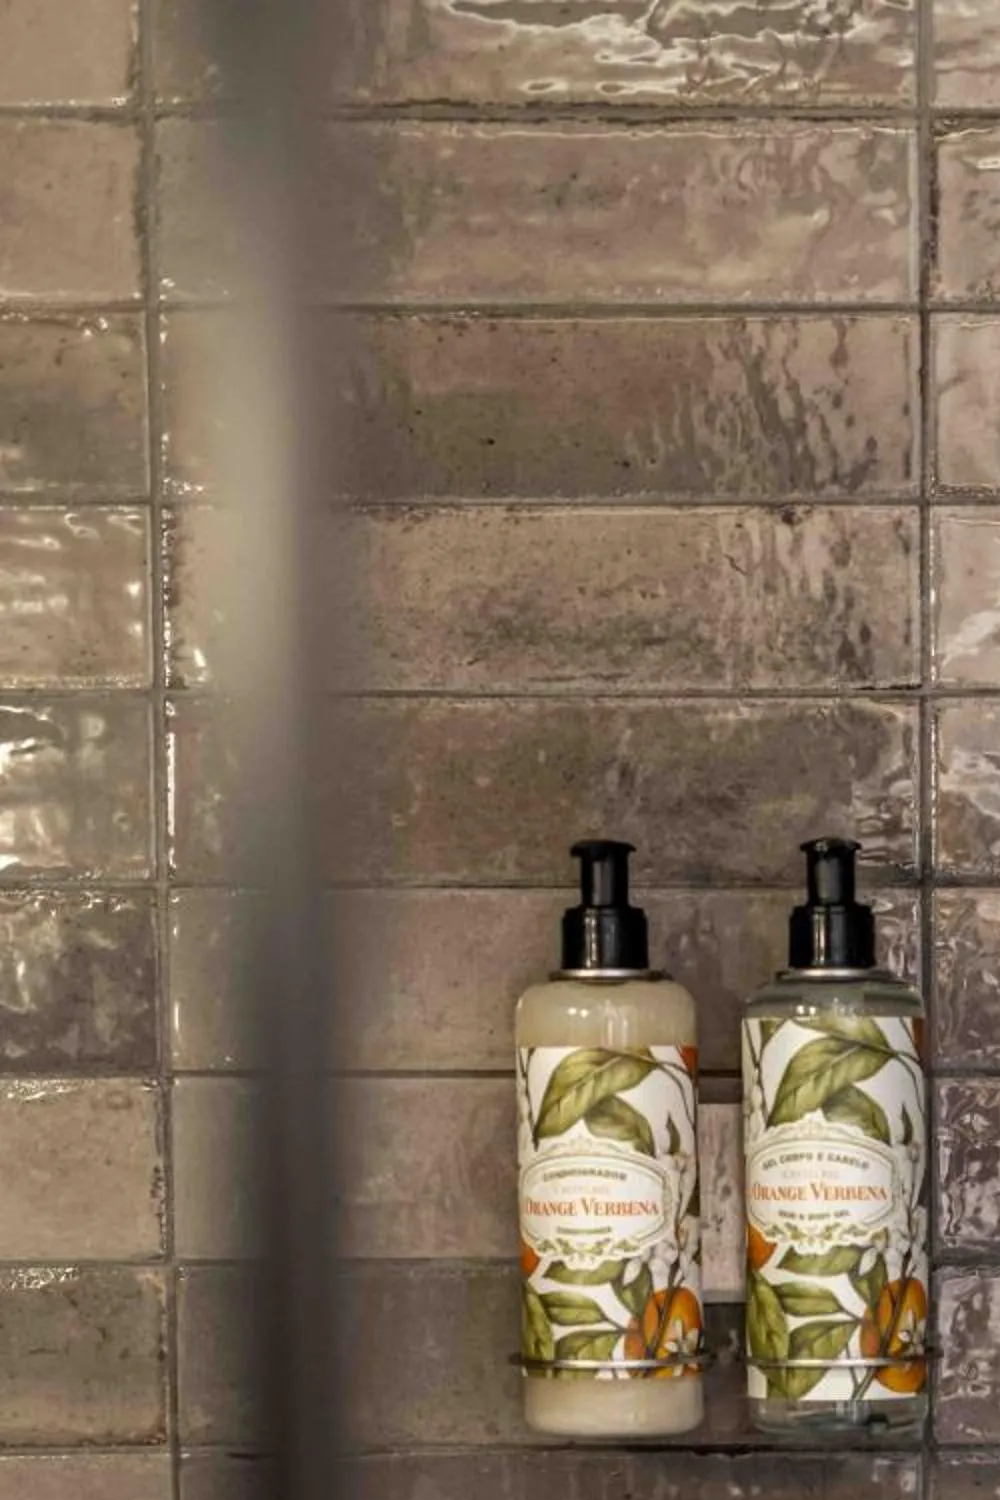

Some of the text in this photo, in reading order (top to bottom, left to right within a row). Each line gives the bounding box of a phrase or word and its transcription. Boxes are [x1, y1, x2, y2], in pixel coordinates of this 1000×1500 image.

[752, 1182, 888, 1201] ORANGE VERBENA
[526, 1197, 659, 1216] ORANGE VERBENA
